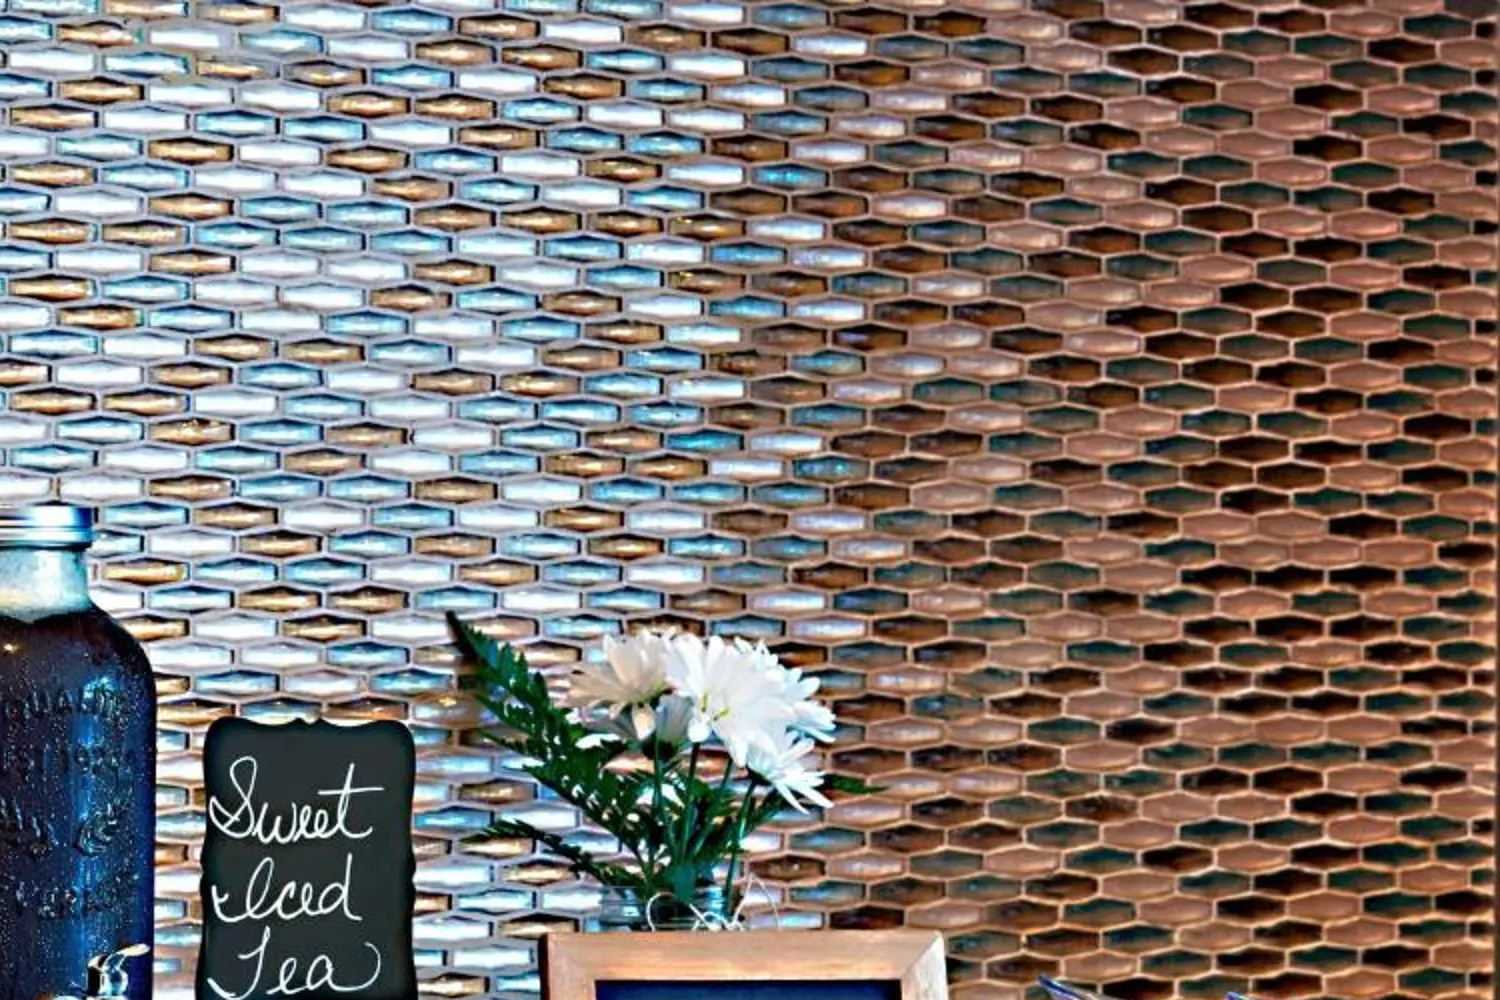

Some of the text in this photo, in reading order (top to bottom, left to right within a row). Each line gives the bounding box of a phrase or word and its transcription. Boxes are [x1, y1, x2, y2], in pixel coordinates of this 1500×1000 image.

[209, 755, 384, 843] Sweet
[211, 853, 362, 922] Iced
[207, 925, 381, 1000] Tea
